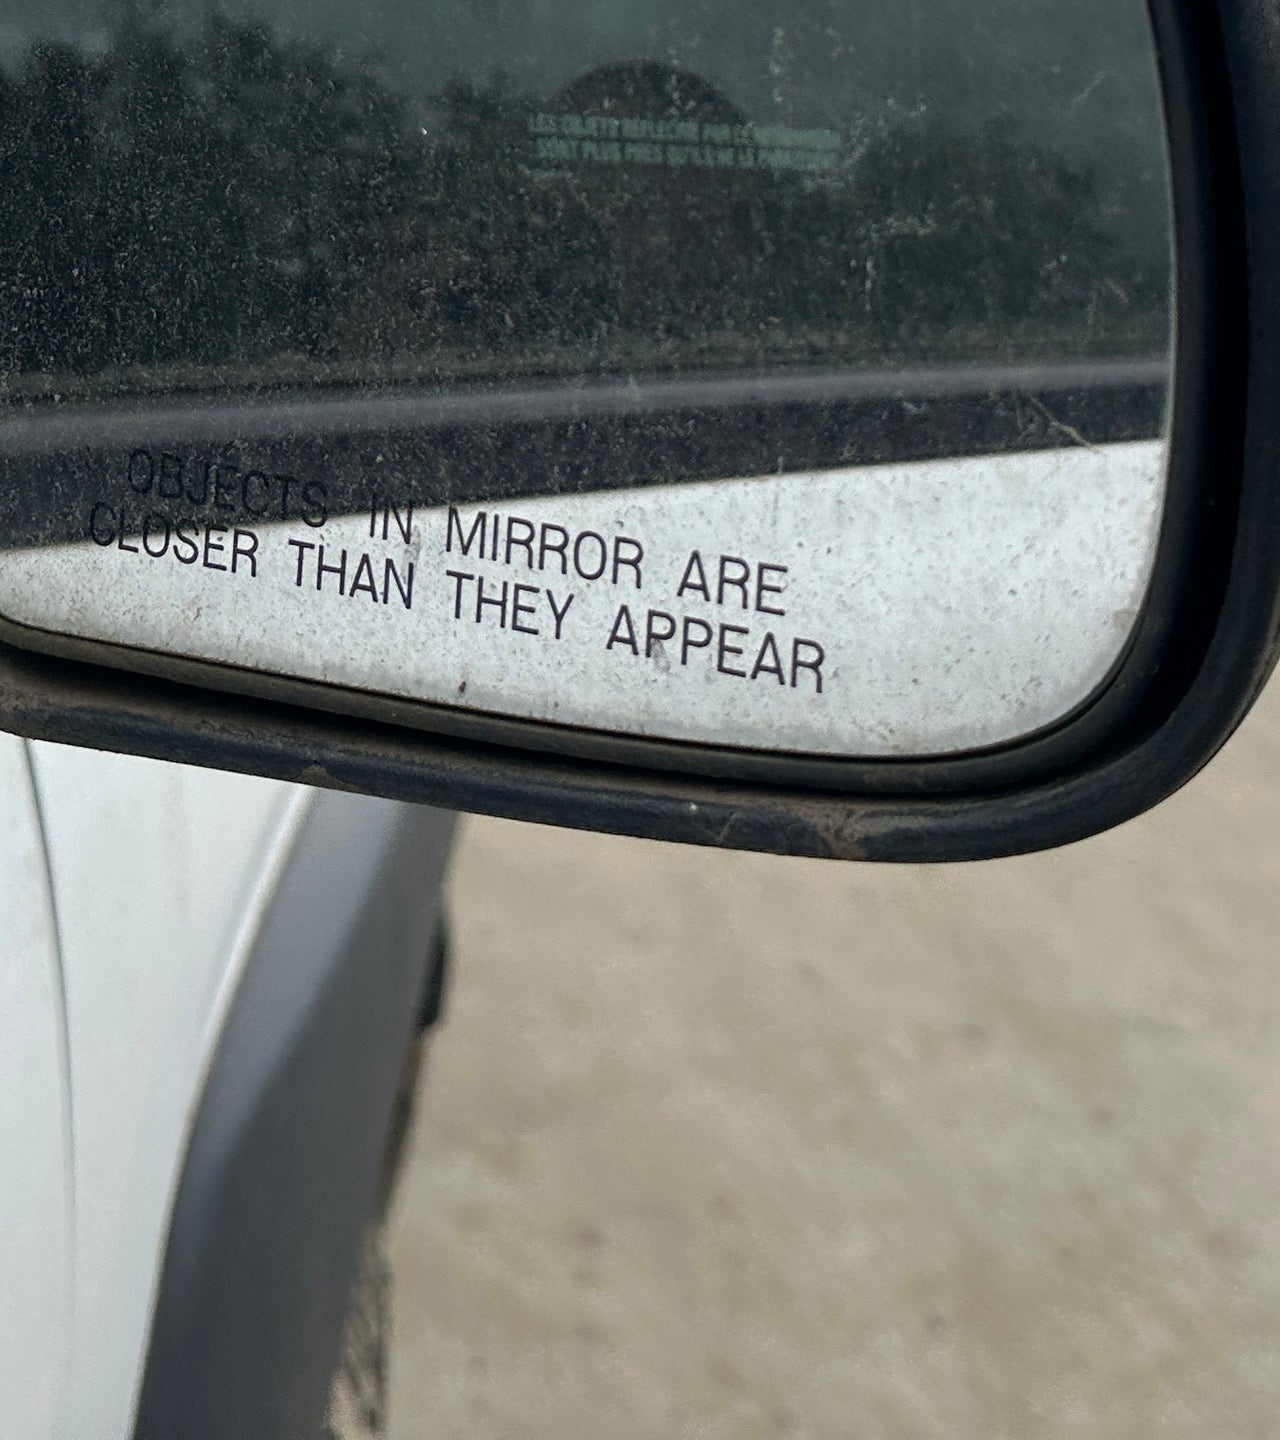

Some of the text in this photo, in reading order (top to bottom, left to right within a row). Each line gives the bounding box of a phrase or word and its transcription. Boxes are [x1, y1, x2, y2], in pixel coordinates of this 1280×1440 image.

[89, 500, 826, 693] CLOSER THAN THEY APPEAR
[126, 448, 790, 616] OBJECTS IN MIRROR ARE
